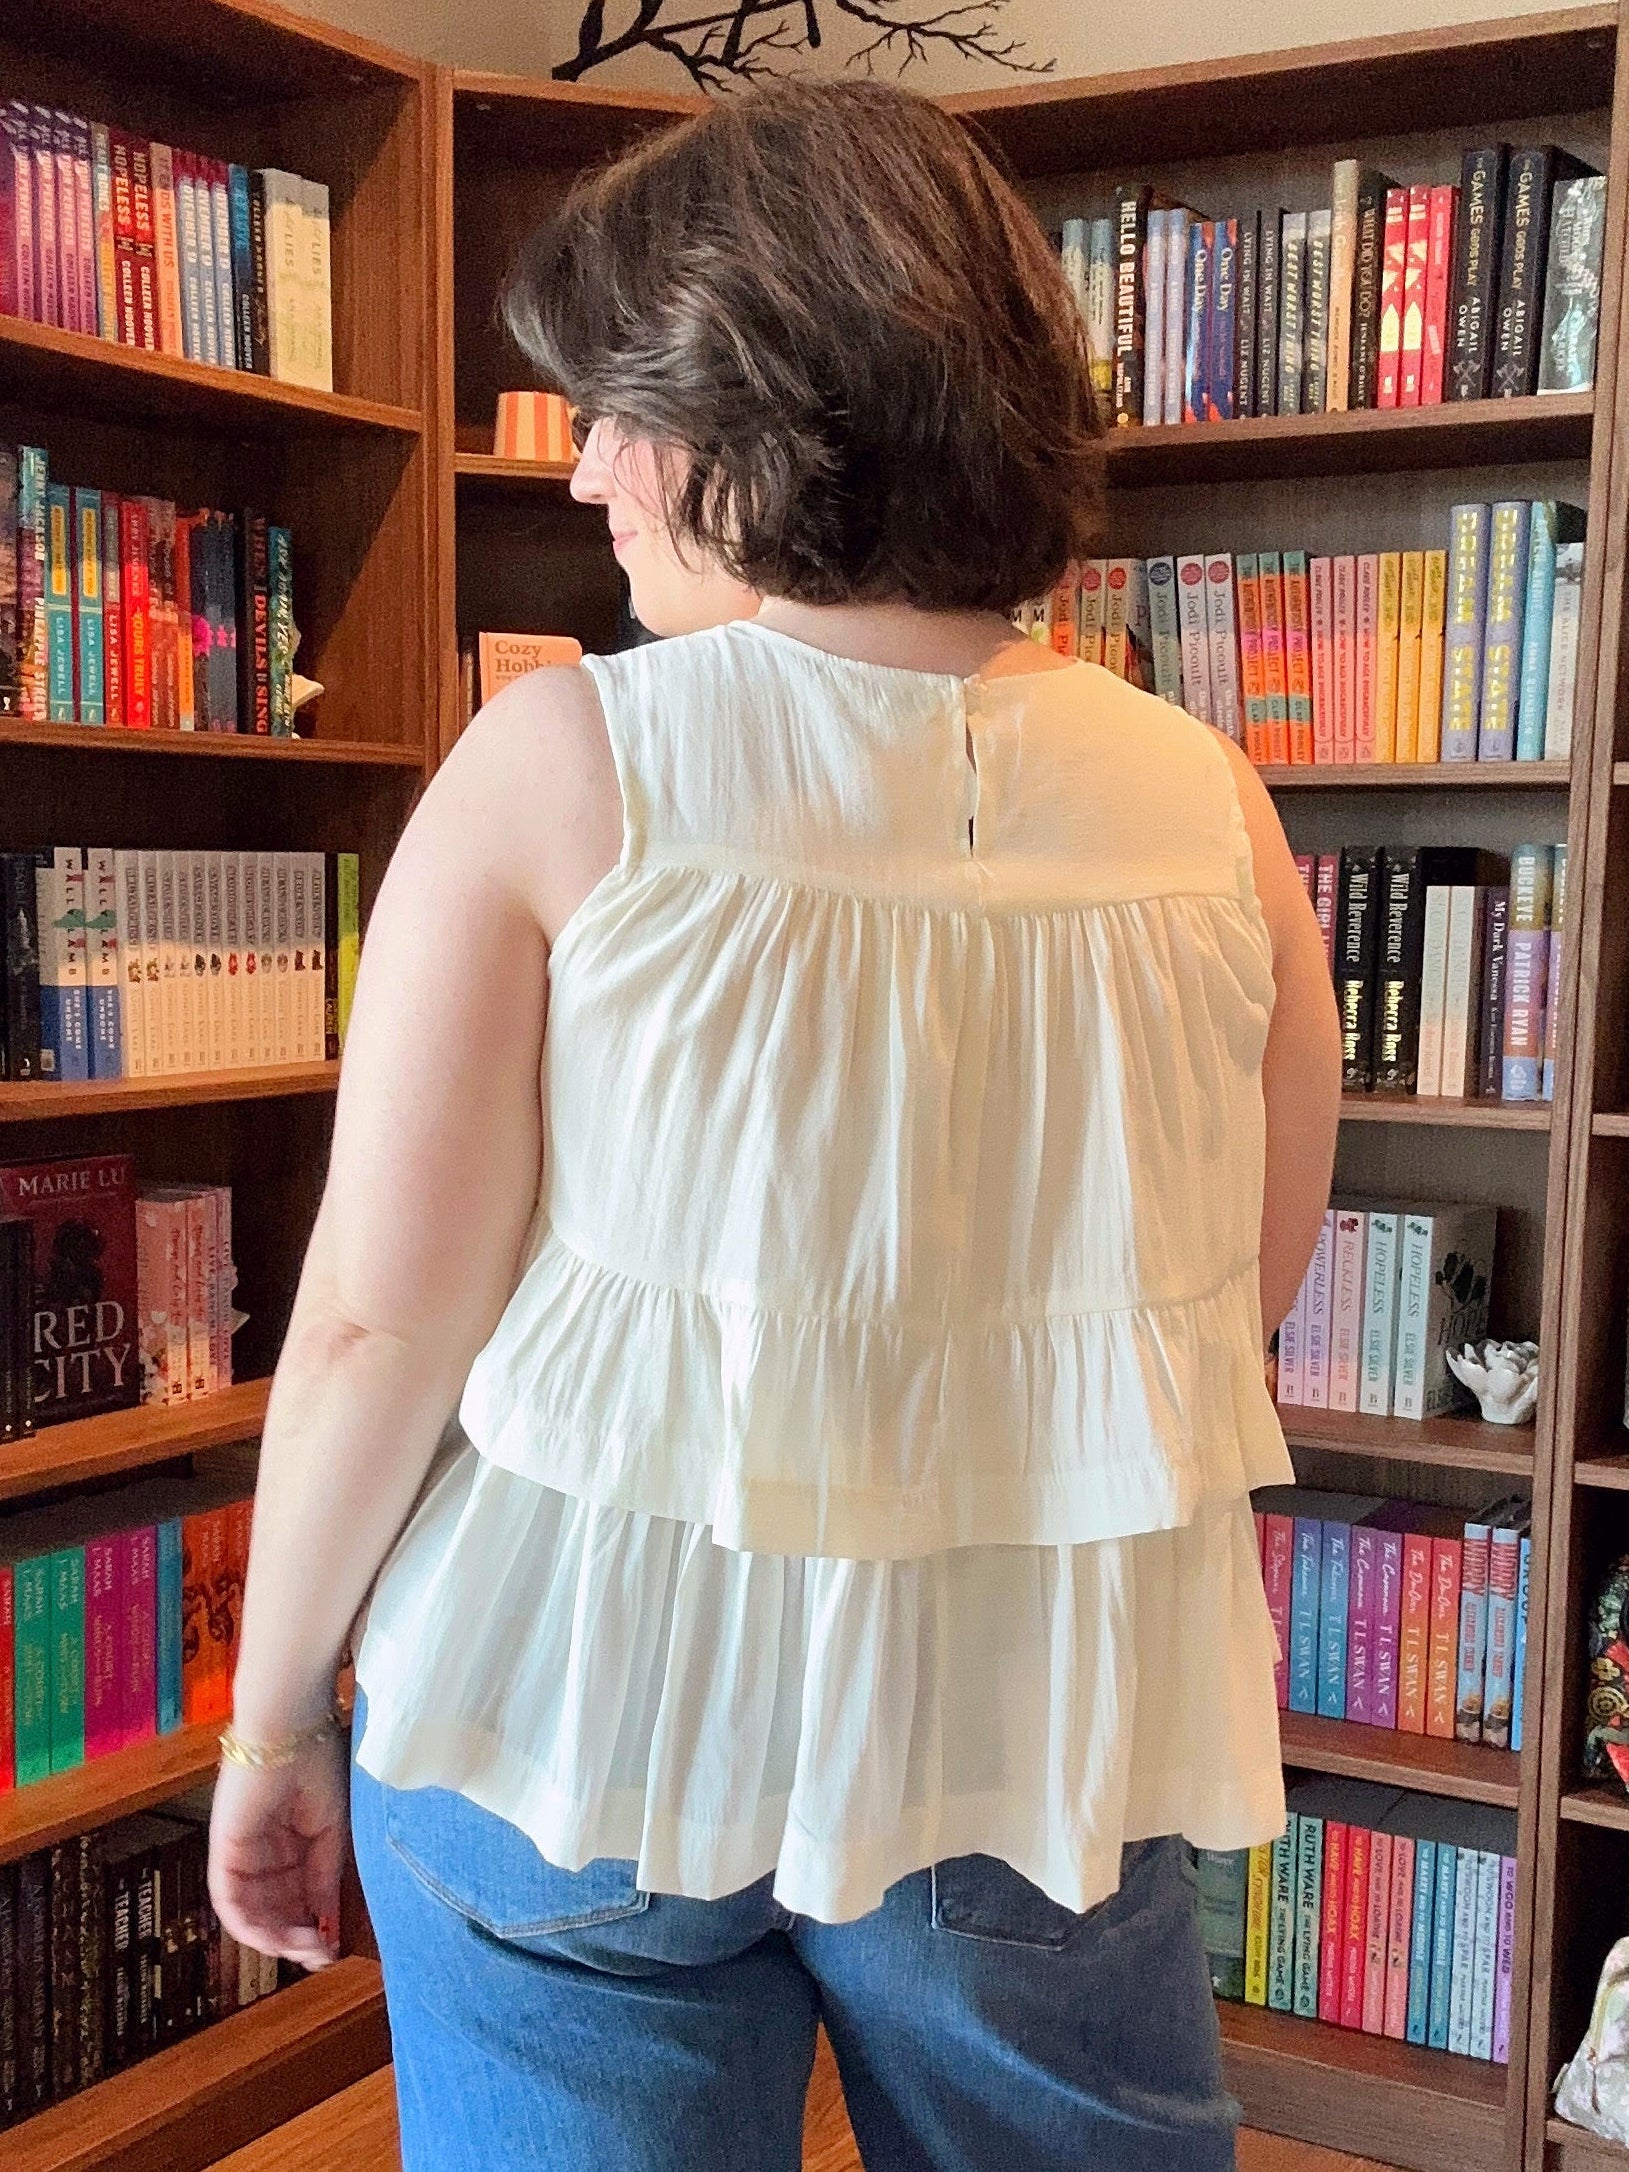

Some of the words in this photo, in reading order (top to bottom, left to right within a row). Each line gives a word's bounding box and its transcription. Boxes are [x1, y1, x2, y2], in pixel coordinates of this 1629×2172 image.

[19, 178, 30, 237] PERFECTS
[99, 173, 111, 212] BONES
[133, 151, 150, 230] HOPELESS
[1470, 170, 1486, 224] GAMES
[1515, 172, 1533, 227] GAMES
[43, 183, 54, 241] PERFECTS
[63, 188, 74, 245] PERFECTS
[81, 192, 92, 251] PERFECTS
[113, 145, 131, 225] HOPELESS
[122, 260, 132, 304] COLLEEN
[162, 213, 173, 246] WITH
[1119, 201, 1137, 255] HELLO
[1363, 208, 1375, 239] WHAT
[285, 233, 294, 267] LIES
[312, 242, 322, 275] LIES
[1196, 249, 1207, 281] One
[1220, 247, 1232, 279] One
[1243, 232, 1252, 265] LYING
[1287, 243, 1298, 279] BEST
[1313, 241, 1323, 278] BEST
[1361, 241, 1373, 264] DID
[141, 266, 151, 309] COLLEEN
[1360, 267, 1373, 290] YOU
[1467, 260, 1479, 287] PLAY
[1512, 263, 1525, 291] PLAY
[189, 277, 199, 320] COLLEEN
[205, 281, 215, 322] COLLEEN
[220, 282, 230, 324] COLLEEN
[242, 294, 251, 332] COLLEEN
[1117, 262, 1135, 357] BEAUTIFUL
[1217, 284, 1231, 311] Day
[1242, 286, 1251, 315] WAIT
[1263, 285, 1274, 313] WAIT
[1286, 283, 1296, 328] WORST
[1311, 280, 1322, 325] WORST
[1359, 292, 1372, 317] DO?
[1457, 305, 1468, 348] OWEN
[1469, 296, 1482, 353] ABIGAIL
[1501, 308, 1513, 351] OWEN
[1513, 300, 1526, 357] ABIGAIL
[244, 334, 253, 369] HOOVER
[1286, 333, 1295, 373] THING
[1310, 330, 1321, 371] THING
[1239, 361, 1249, 406] NUGENT
[1261, 361, 1270, 405] NUGENT
[34, 501, 45, 561] JACKSON
[1085, 595, 1096, 628] Jodi
[1110, 594, 1122, 626] Jodi
[1156, 592, 1170, 623] Jodi
[1187, 592, 1200, 625] Jodi
[1213, 590, 1228, 622] Jodi
[34, 597, 46, 665] PINEAPPLE
[56, 616, 65, 643] LISA
[87, 619, 96, 645] LISA
[109, 615, 118, 644] LISA
[133, 612, 143, 655] YOURS
[255, 595, 267, 669] DEVILS
[277, 623, 288, 654] YES
[495, 640, 542, 658] Cozy
[1561, 617, 1571, 648] ALICE
[56, 649, 66, 695] JEWELL
[1158, 630, 1171, 685] Picoult
[1189, 632, 1201, 687] Picoult
[1215, 630, 1229, 685] Picoult
[1363, 650, 1370, 660] TO
[1527, 641, 1537, 671] ANNA
[133, 658, 144, 696] TRULY
[1450, 648, 1474, 730] STATE
[1484, 645, 1512, 730] STATE
[256, 686, 268, 733] SING
[98, 860, 110, 917] WALLY
[1318, 865, 1333, 892] THE
[1349, 873, 1368, 899] Wild
[1390, 873, 1409, 899] Wild
[1516, 856, 1535, 921] BUCKEYE
[1490, 901, 1506, 917] My
[67, 928, 76, 975] LAMB
[1346, 903, 1365, 962] Reverence
[1387, 903, 1405, 962] Reverence
[1492, 923, 1505, 951] Dark
[1490, 957, 1503, 1000] Vanessa
[1512, 942, 1531, 1002] PATRICK
[65, 999, 73, 1042] UNDONE
[99, 999, 107, 1041] UNDONE
[1344, 980, 1364, 1028] Rebecca
[1383, 981, 1404, 1030] Rebecca
[1343, 1033, 1360, 1060] Ross
[1511, 1009, 1528, 1045] RYAN
[1382, 1034, 1401, 1061] Ross
[19, 1171, 89, 1196] MARIE
[99, 1167, 125, 1187] LU
[1313, 1233, 1327, 1315] POWERLESS
[1341, 1240, 1354, 1311] RECKLESS
[1372, 1241, 1387, 1313] HOPELESS
[1407, 1243, 1424, 1317] HOPELESS
[34, 1300, 124, 1353] RED
[1285, 1322, 1295, 1344] ELSIE
[1340, 1328, 1349, 1349] ELSIE
[1370, 1330, 1380, 1350] ELSIE
[1405, 1332, 1414, 1353] ELSIE
[1369, 1354, 1379, 1381] SILVER
[1403, 1358, 1414, 1384] SILVER
[1301, 1532, 1314, 1551] The
[1331, 1537, 1344, 1555] The
[1358, 1537, 1370, 1555] The
[1382, 1543, 1396, 1560] The
[1410, 1550, 1424, 1569] The
[104, 1547, 113, 1590] SARAH
[1439, 1555, 1452, 1574] The
[1298, 1636, 1310, 1677] SWAN
[1328, 1641, 1340, 1684] SWAN
[1353, 1645, 1366, 1689] SWAN
[1379, 1651, 1391, 1694] SWAN
[1405, 1654, 1418, 1696] SWAN
[1434, 1660, 1446, 1702] SWAN
[1304, 1824, 1316, 1864] RUTH
[1329, 1843, 1339, 1870] HAVE
[1375, 1849, 1384, 1873] LOVE
[1278, 1863, 1291, 1901] WARE
[1397, 1854, 1407, 1878] LOVE
[1302, 1869, 1315, 1908] WARE
[115, 1892, 129, 1951] TEACHER
[138, 1880, 152, 1940] TEACHER
[1348, 1906, 1360, 1939] HOAX
[1303, 1930, 1312, 1960] LYING
[1502, 1949, 1513, 1973] WED
